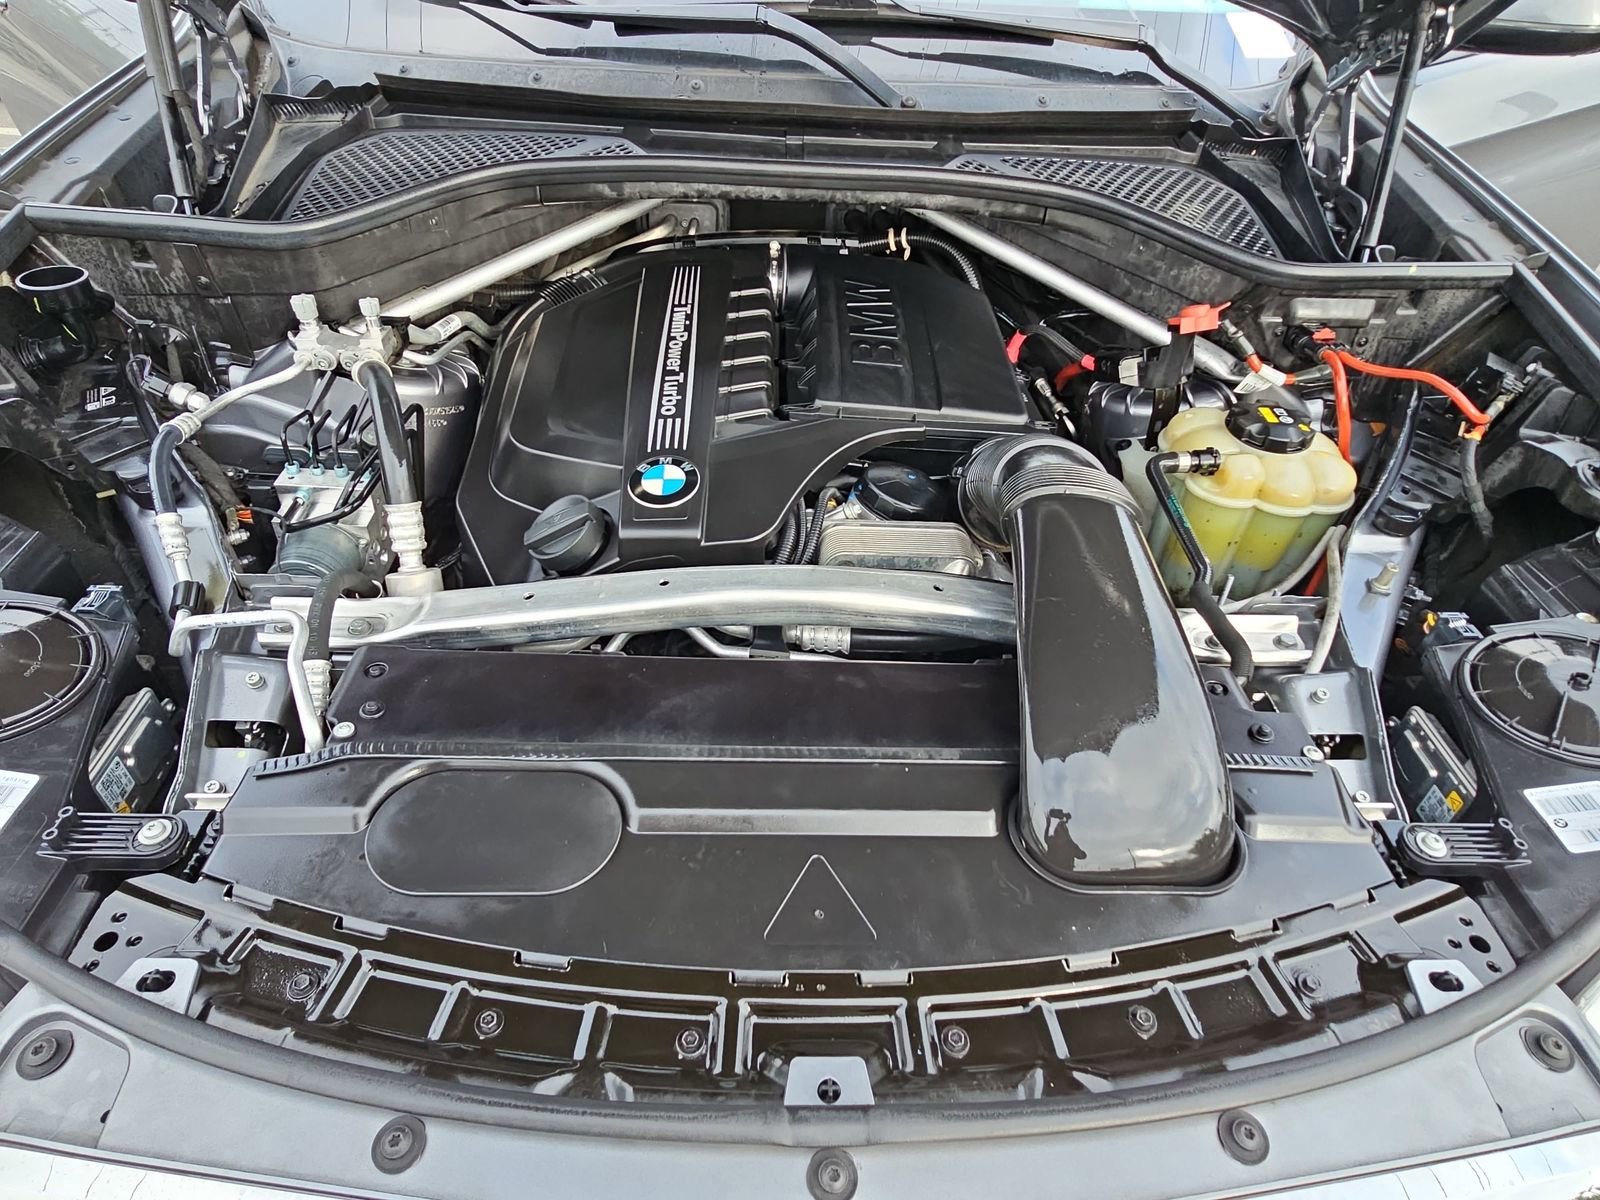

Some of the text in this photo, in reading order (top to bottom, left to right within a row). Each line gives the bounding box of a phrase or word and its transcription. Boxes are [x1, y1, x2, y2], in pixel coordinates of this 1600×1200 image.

[660, 304, 692, 416] TwinPower Turbo
[844, 280, 903, 368] BMW
[636, 457, 695, 473] BMW
